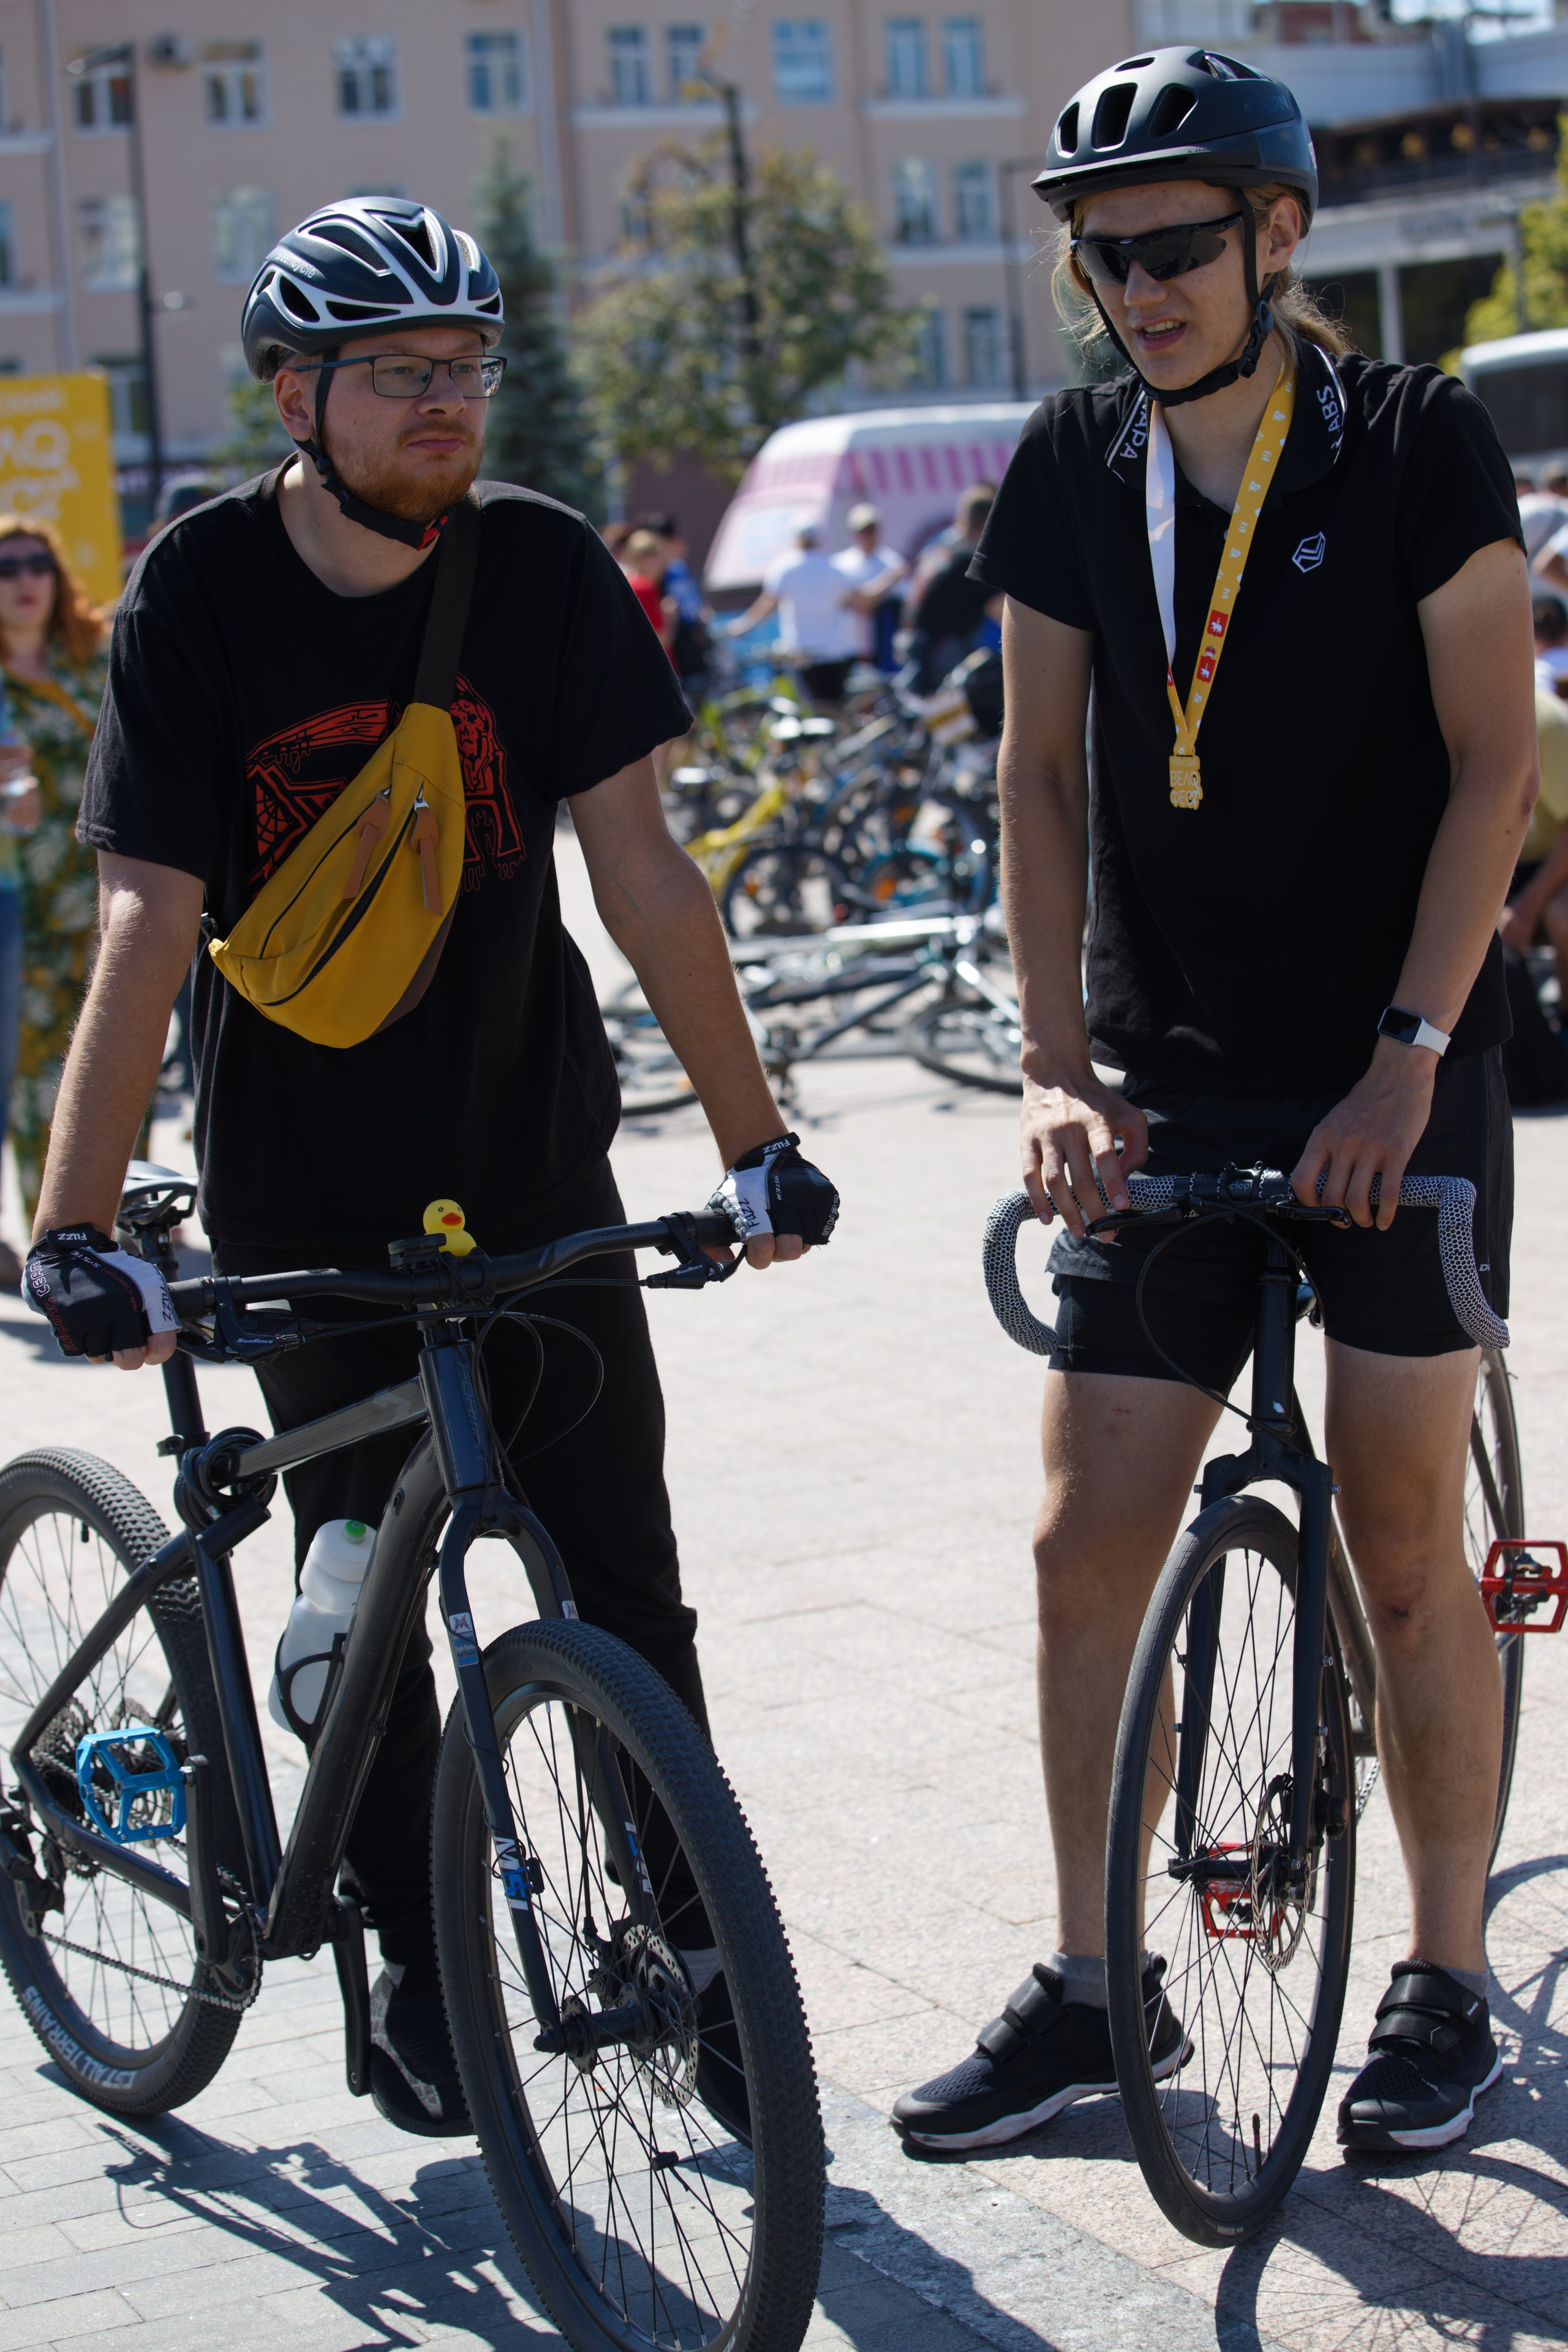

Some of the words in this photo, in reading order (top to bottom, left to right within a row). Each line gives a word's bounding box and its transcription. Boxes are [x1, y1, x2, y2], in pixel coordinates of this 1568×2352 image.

[762, 1139, 791, 1155] FUZZ
[738, 1197, 761, 1229] FUZZ
[57, 1232, 88, 1241] FUZZ
[592, 1226, 643, 1238] FORMAT
[70, 1250, 101, 1268] SYSTE
[20, 1985, 85, 2068] TERRAINS
